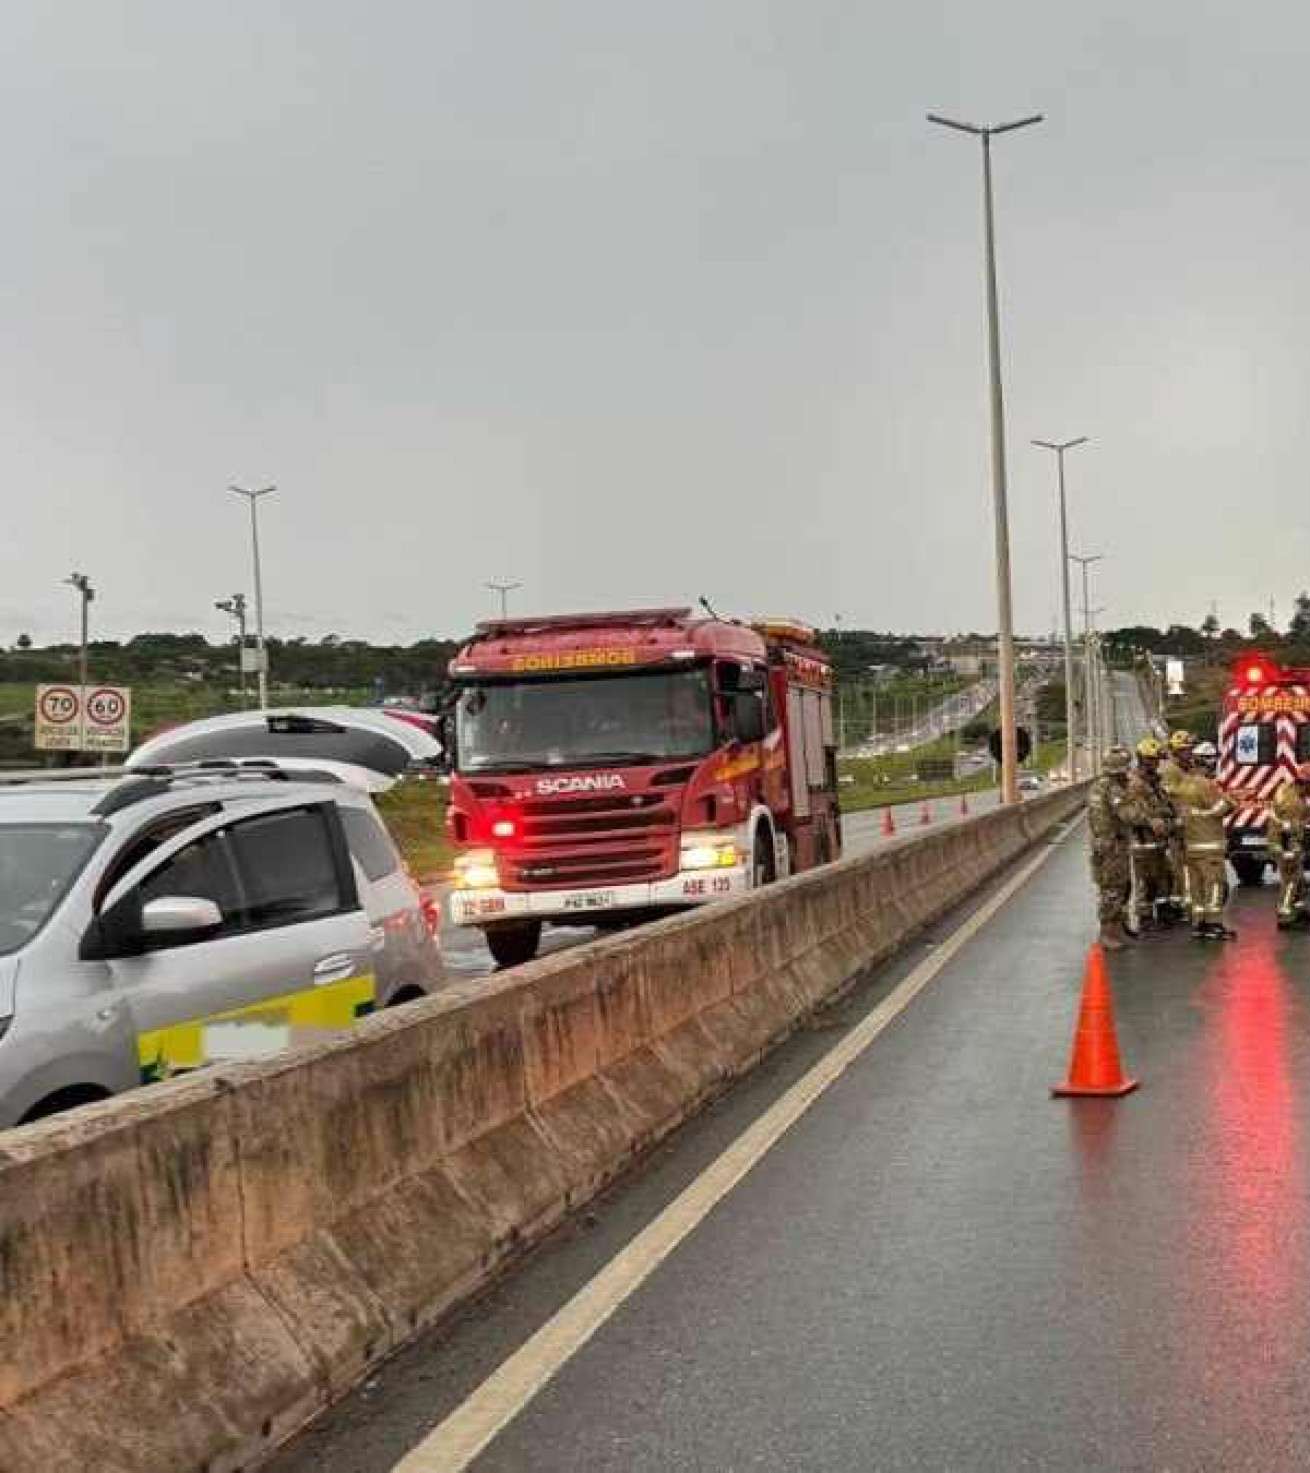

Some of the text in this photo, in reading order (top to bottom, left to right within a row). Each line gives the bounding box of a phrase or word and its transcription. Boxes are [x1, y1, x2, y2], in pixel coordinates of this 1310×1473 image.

[48, 697, 73, 712] 70
[95, 698, 119, 714] 60
[536, 773, 626, 795] SCANIA
